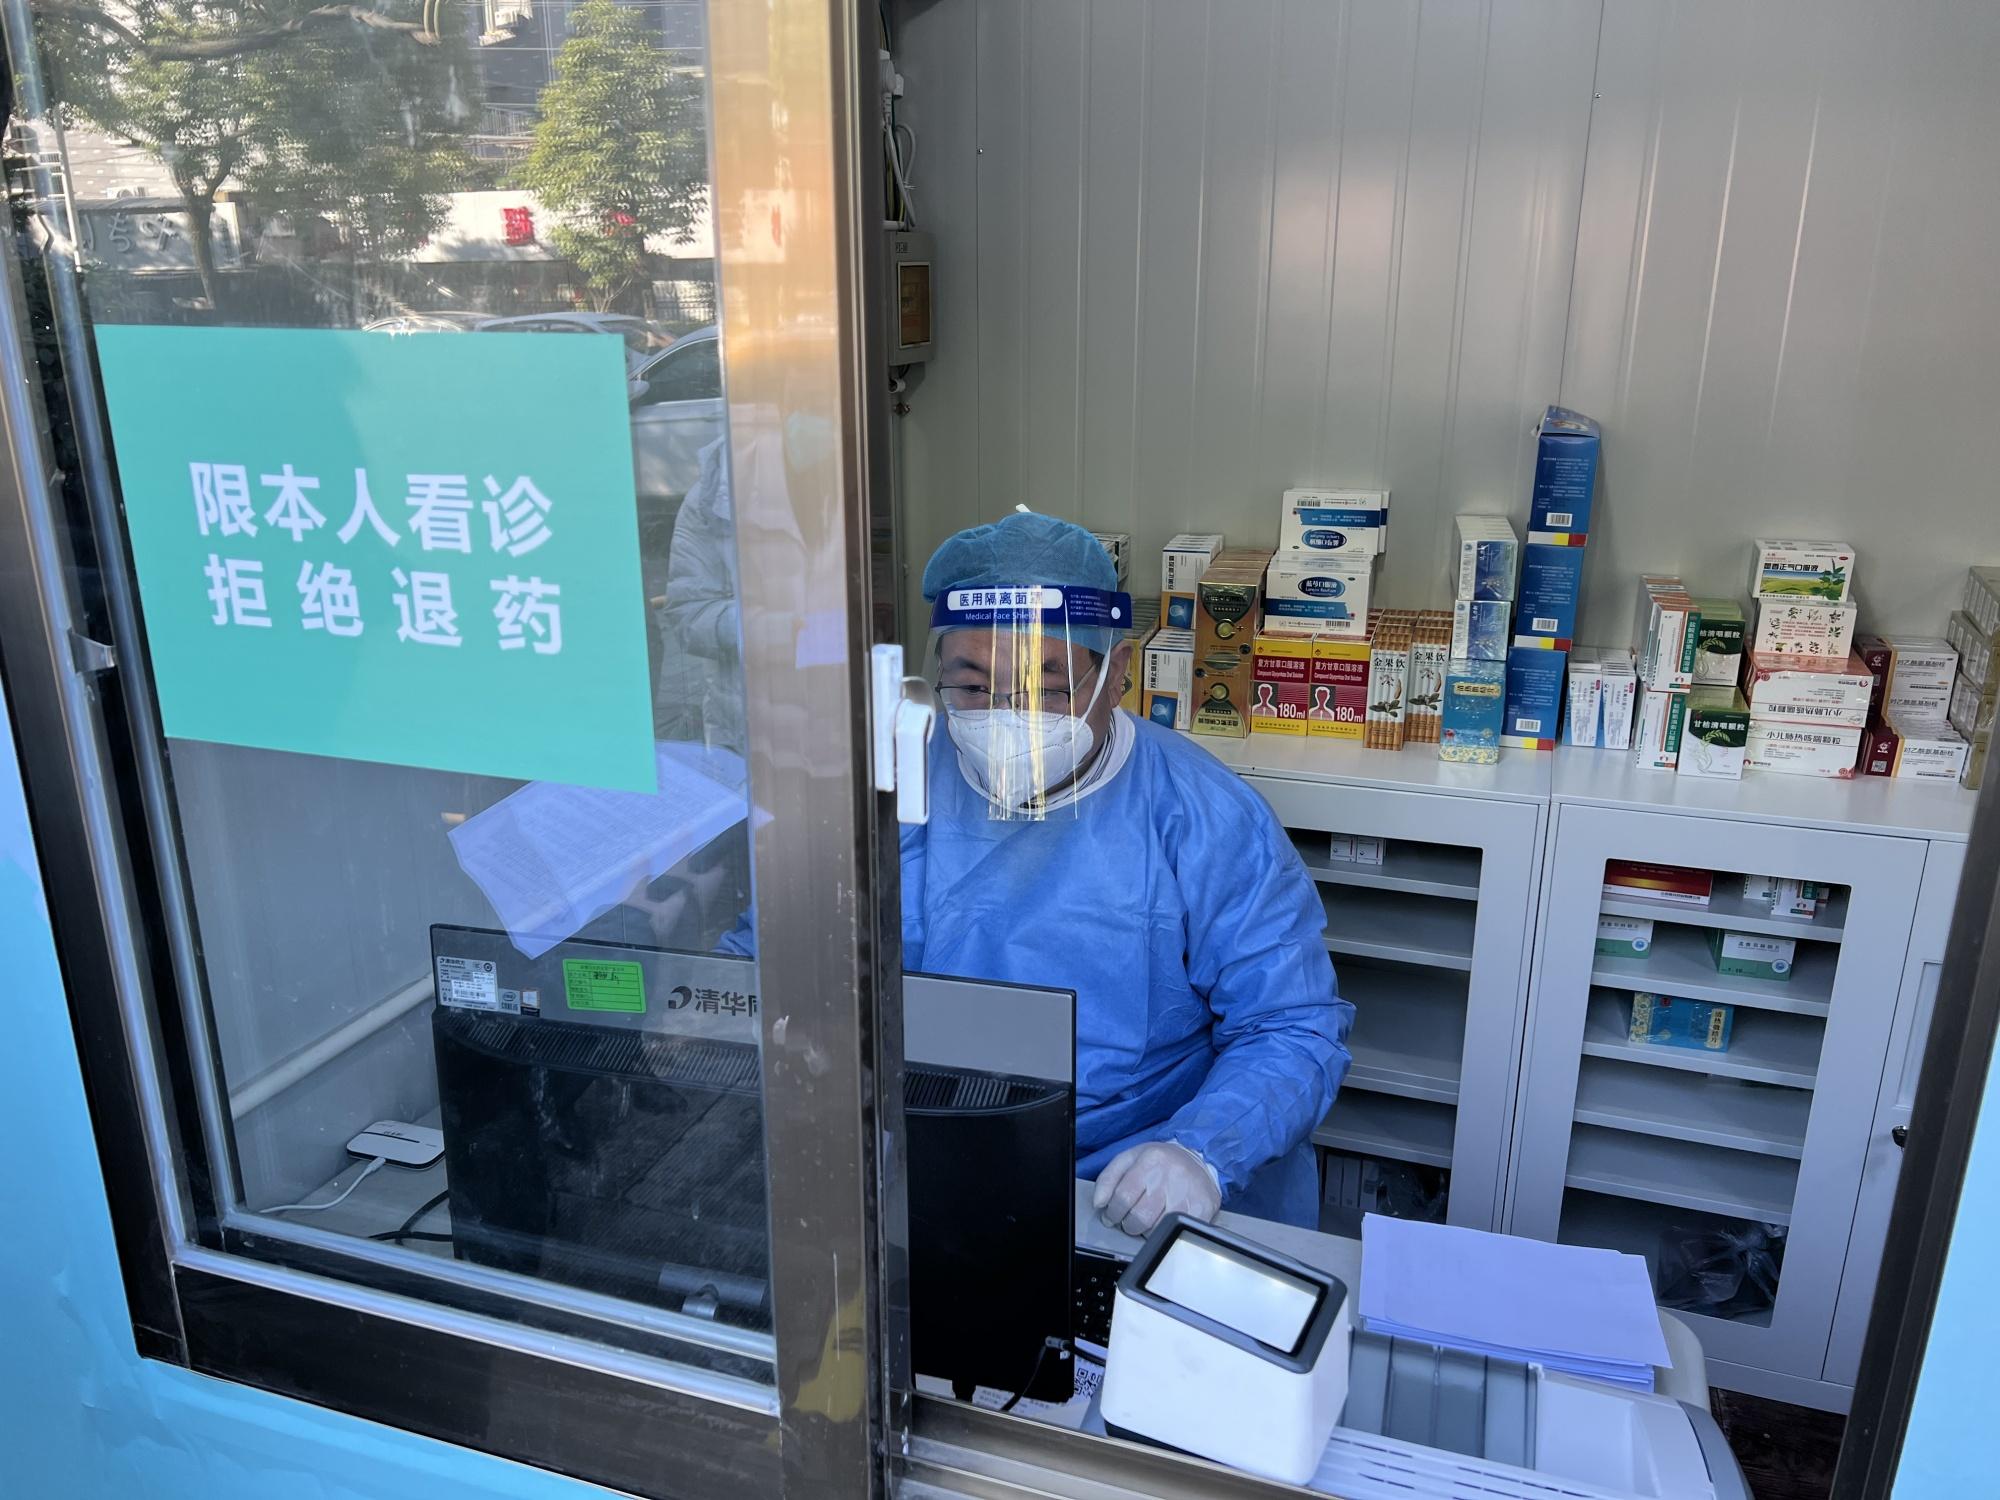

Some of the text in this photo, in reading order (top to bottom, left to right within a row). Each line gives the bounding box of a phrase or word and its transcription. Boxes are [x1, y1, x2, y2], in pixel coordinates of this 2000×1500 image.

[188, 461, 553, 557] 限本人看诊
[203, 554, 563, 655] 拒绝退药
[965, 612, 992, 621] Medical
[993, 611, 1011, 620] Face
[1414, 651, 1446, 662] 金果饮
[1257, 659, 1305, 670] 复方甘草口服溶液
[1315, 661, 1364, 673] 复方甘草口服溶液
[1373, 657, 1406, 669] 金果饮
